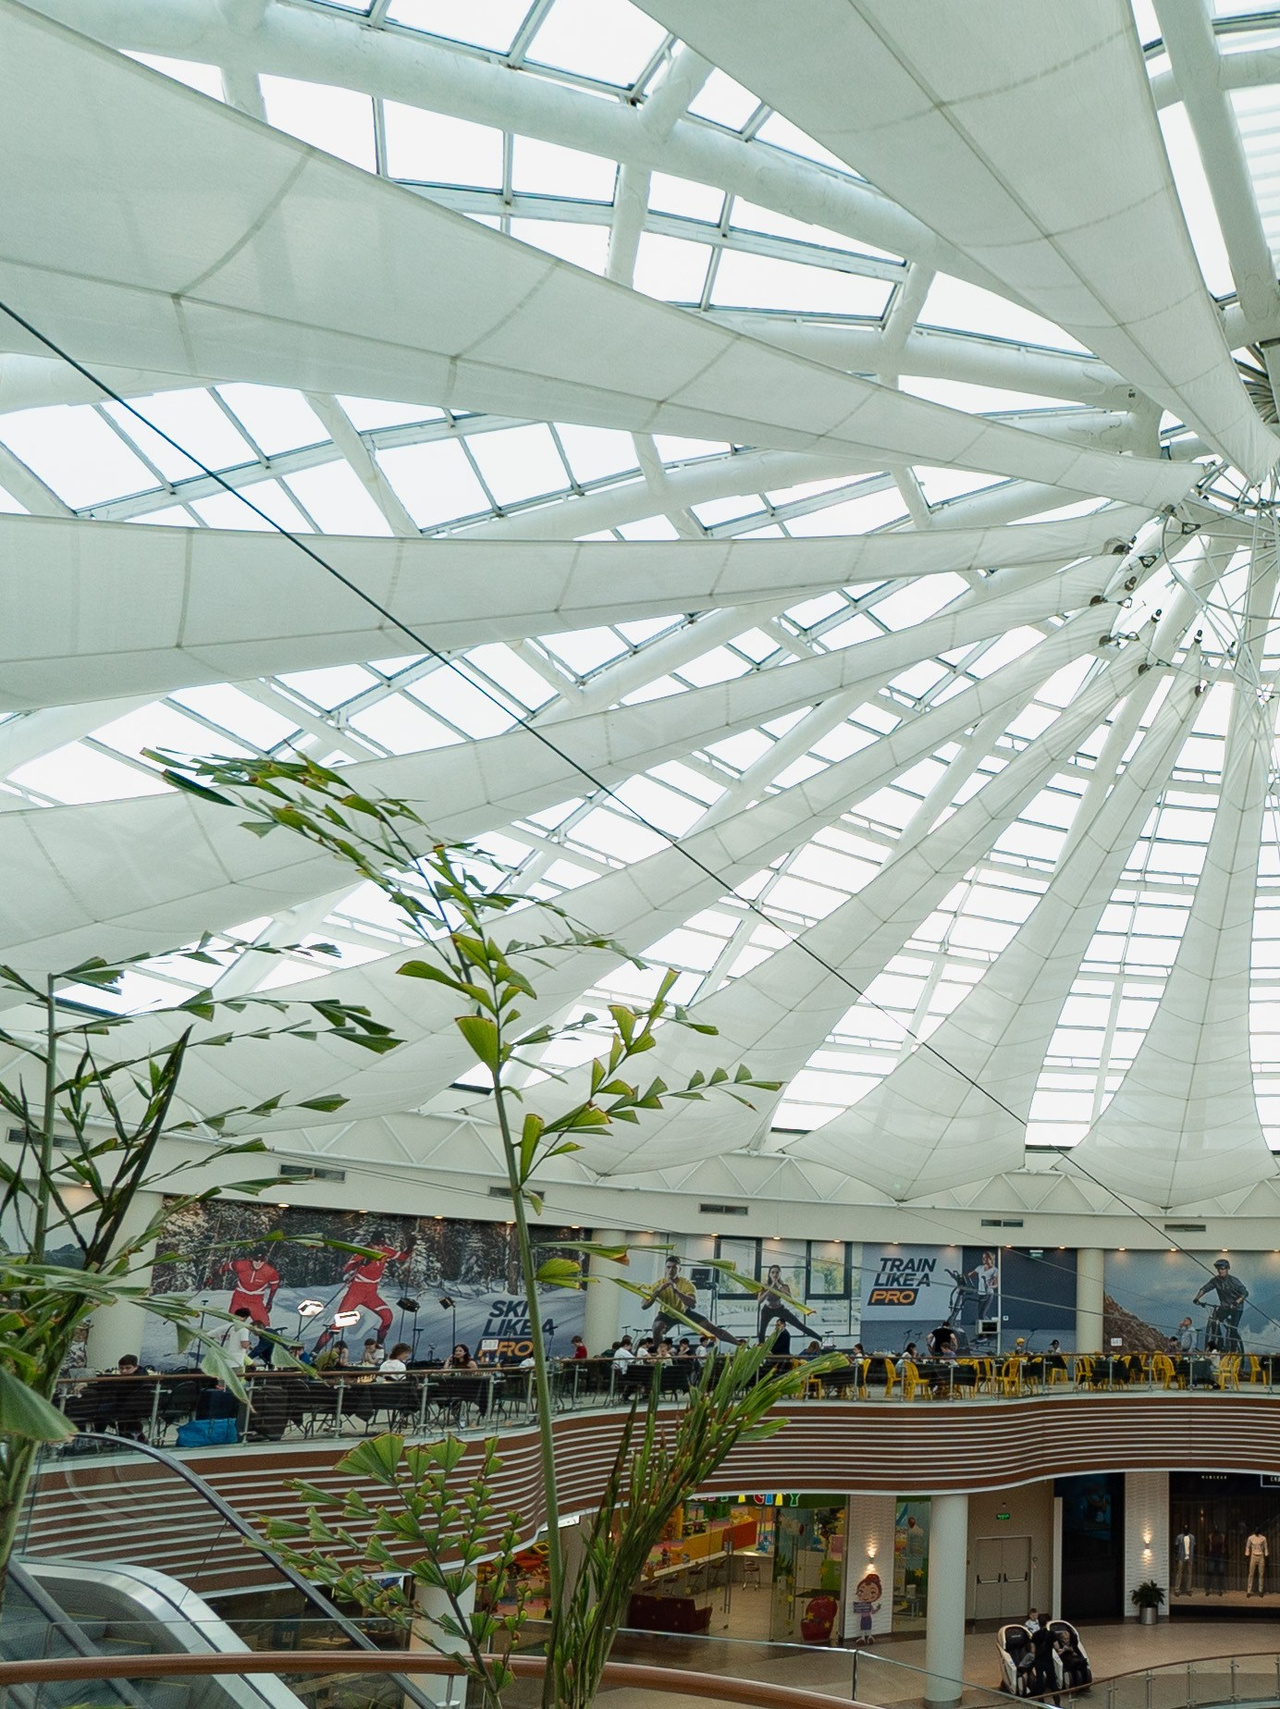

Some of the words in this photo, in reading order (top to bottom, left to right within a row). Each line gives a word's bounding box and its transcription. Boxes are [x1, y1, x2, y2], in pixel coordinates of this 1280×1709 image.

[880, 1257, 937, 1272] TRAIN
[874, 1273, 917, 1287] LIKE
[917, 1273, 930, 1287] A
[871, 1290, 915, 1304] PRO
[489, 1300, 529, 1318] SKI
[482, 1319, 533, 1337] LIKE
[478, 1341, 534, 1357] RO
